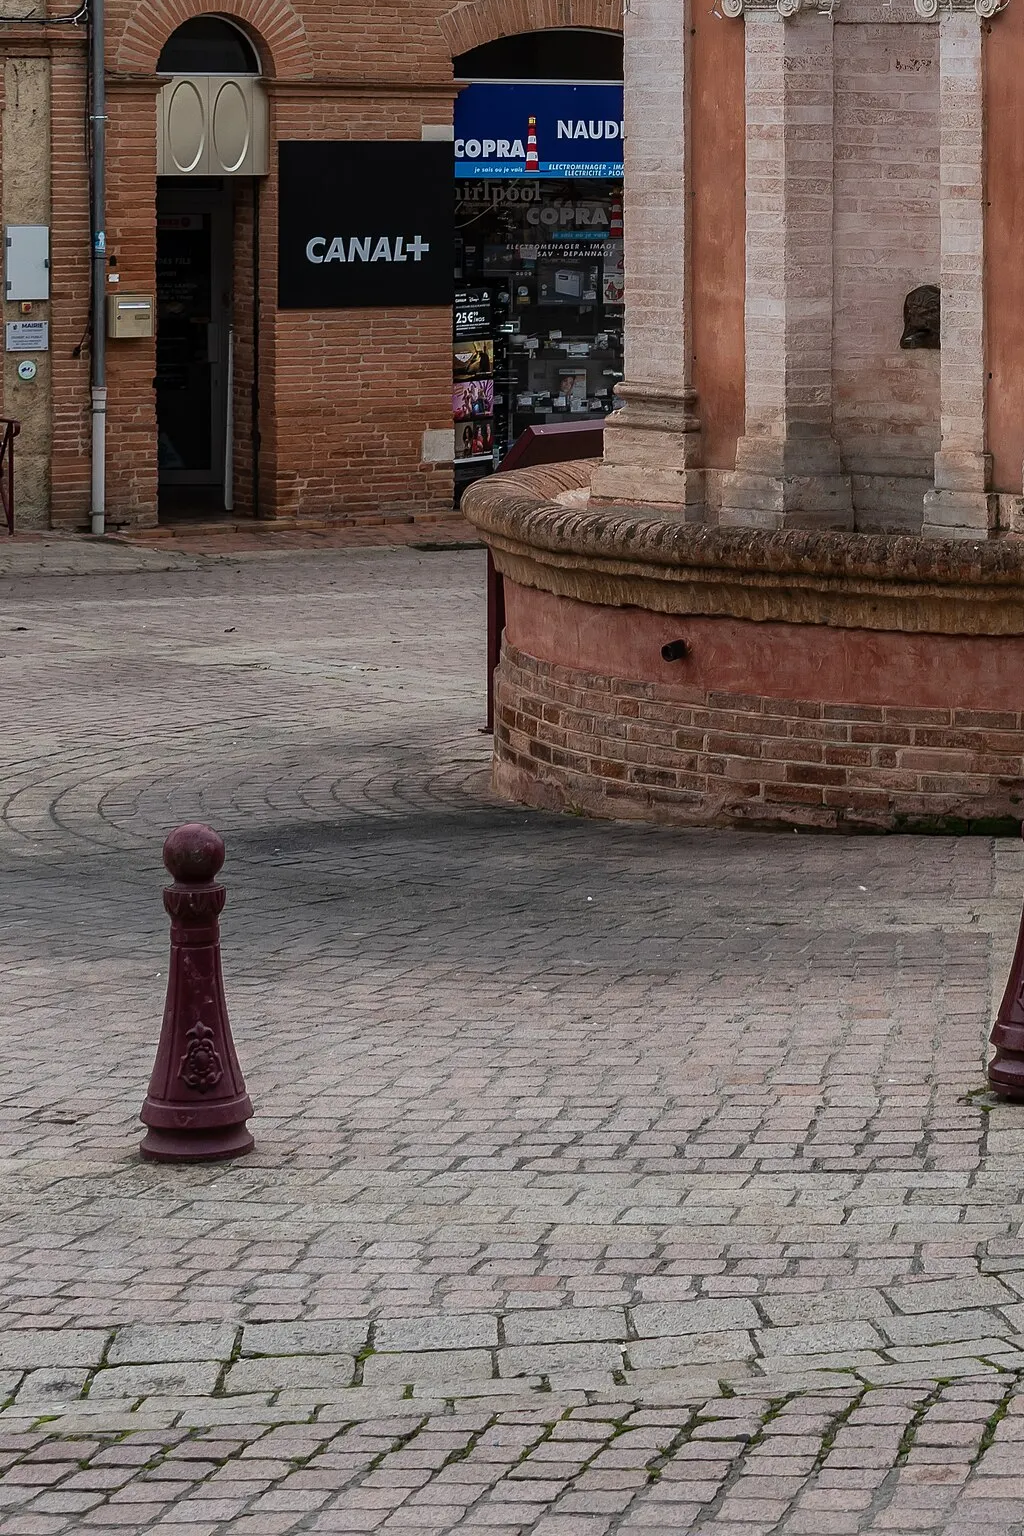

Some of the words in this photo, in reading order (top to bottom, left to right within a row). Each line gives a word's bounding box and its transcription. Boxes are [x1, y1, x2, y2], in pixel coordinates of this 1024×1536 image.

[454, 138, 526, 158] COPRA
[526, 207, 609, 225] COPRA
[305, 235, 430, 264] CANAL+
